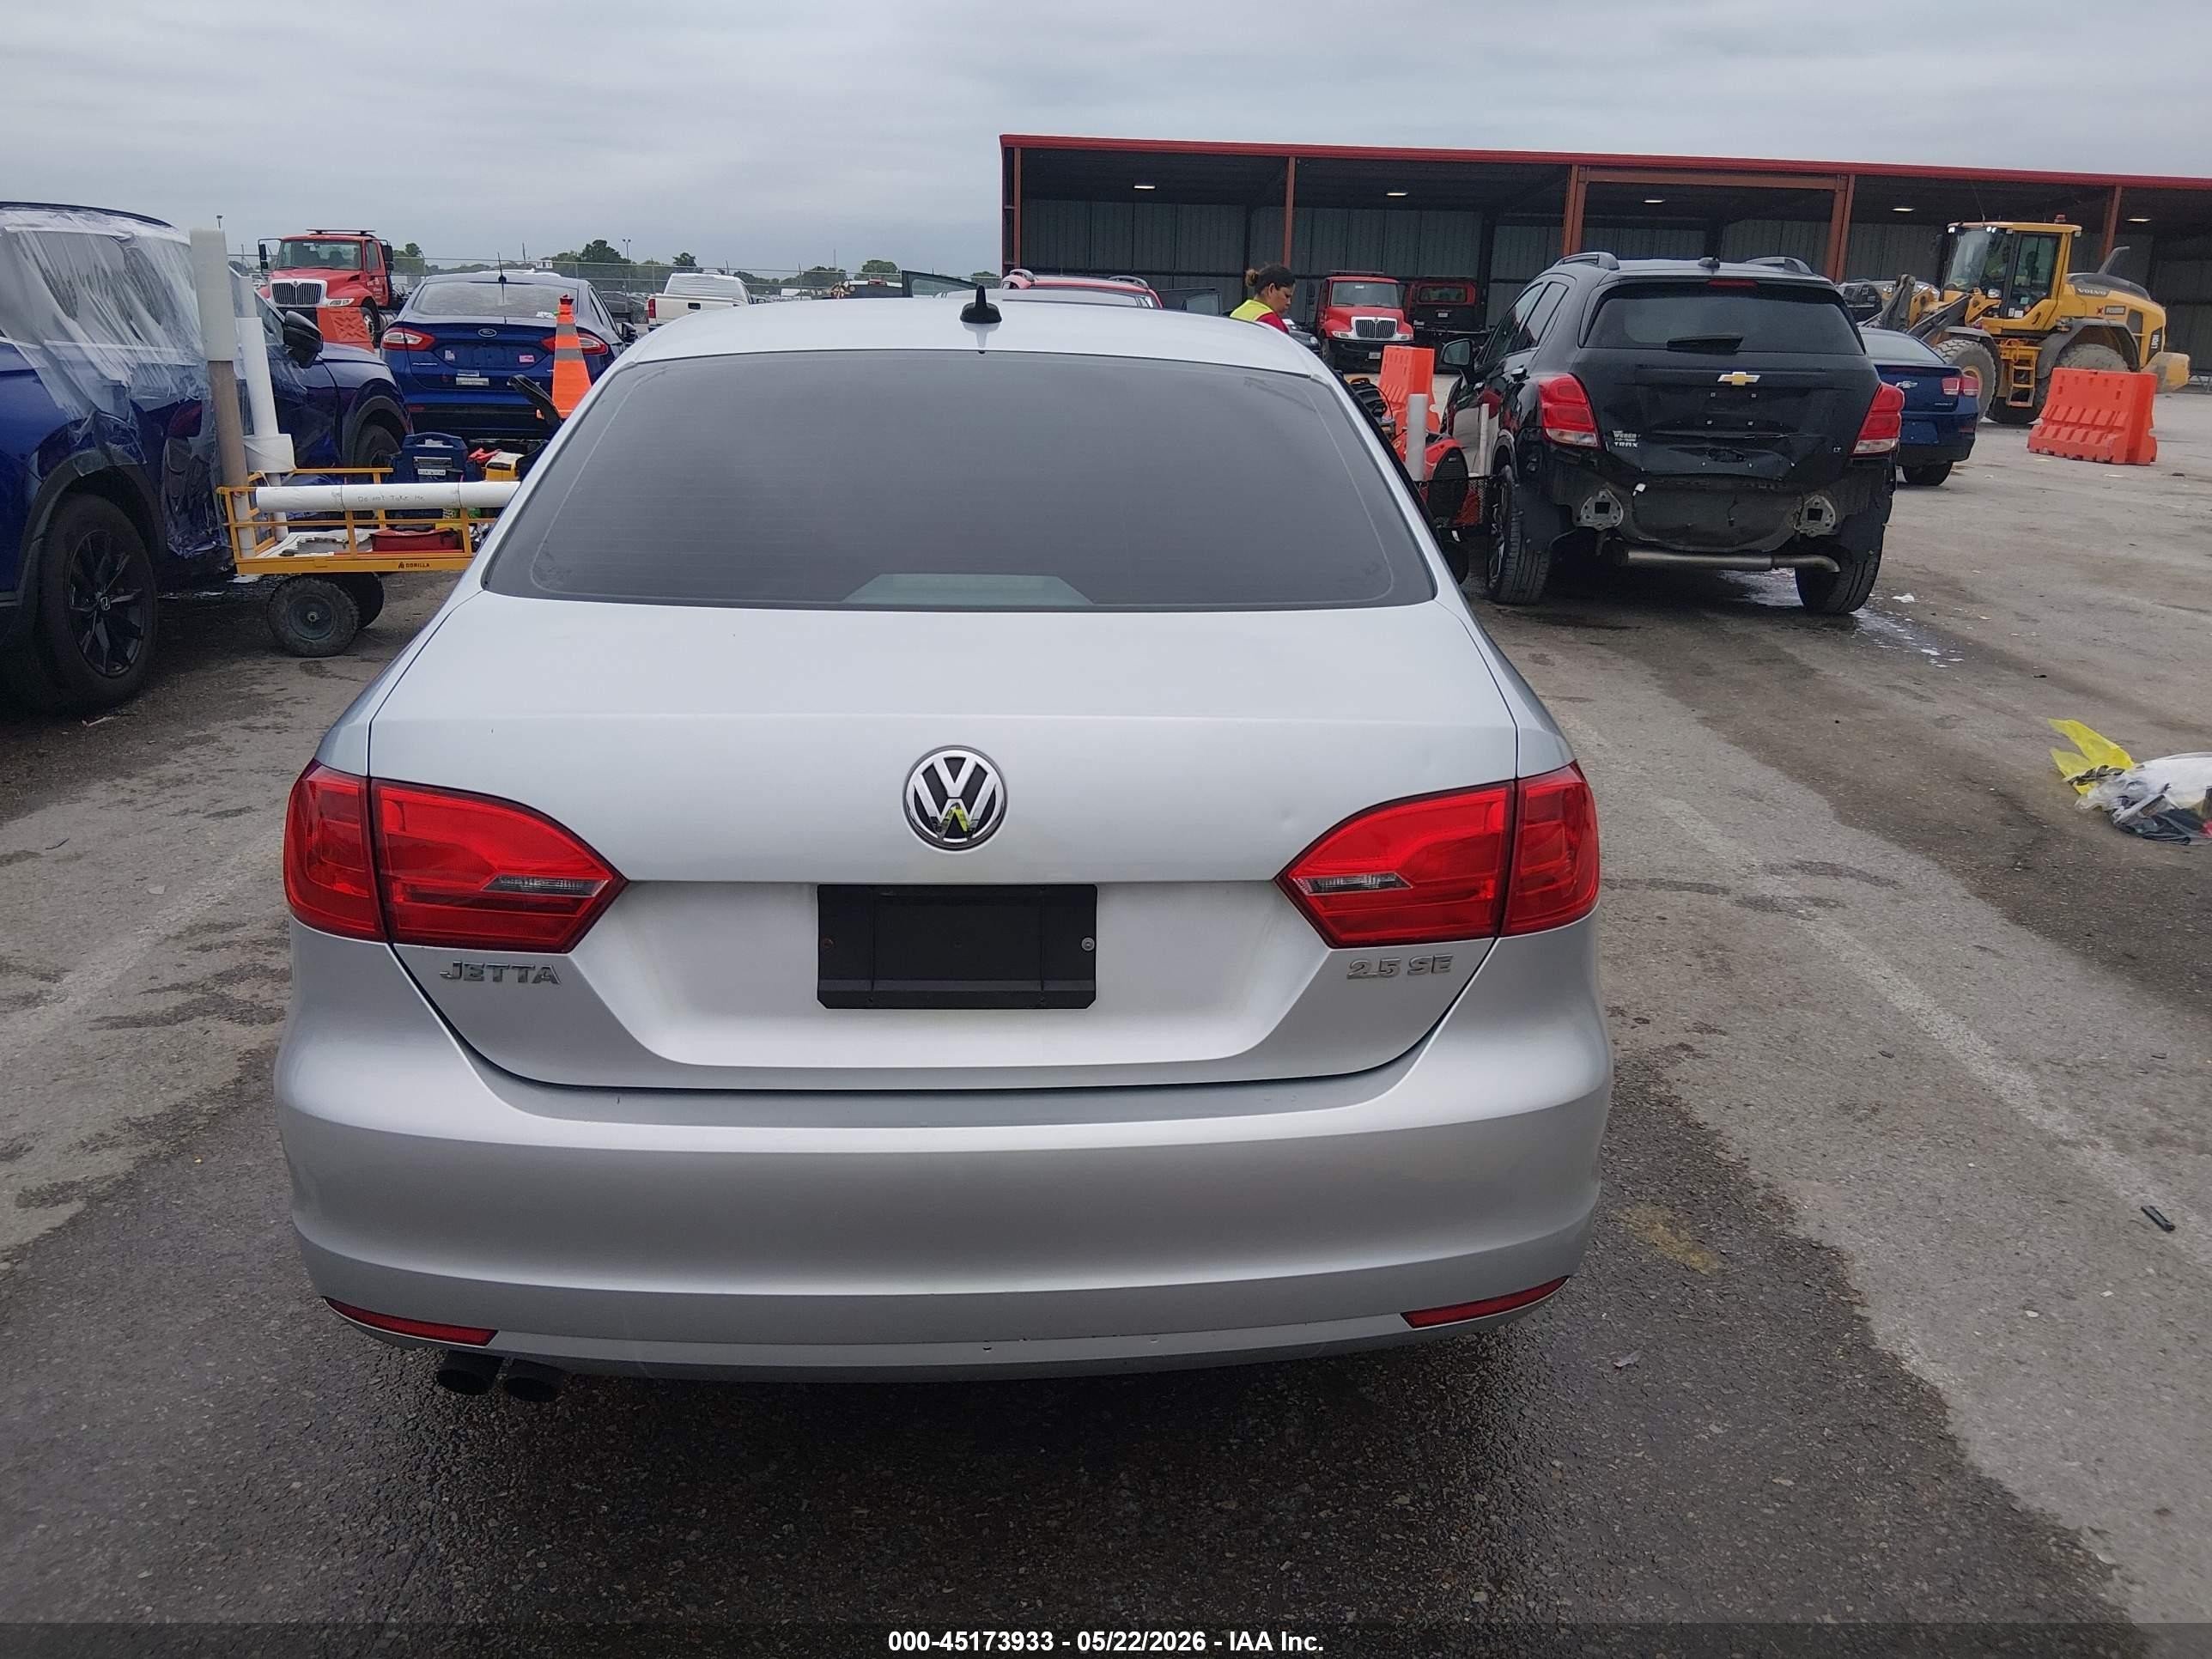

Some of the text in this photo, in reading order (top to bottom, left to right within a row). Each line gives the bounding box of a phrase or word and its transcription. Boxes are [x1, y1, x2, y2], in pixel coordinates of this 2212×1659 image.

[2077, 288, 2107, 296] VOLVO
[439, 960, 562, 985] JETTA
[1407, 953, 1454, 976] SE
